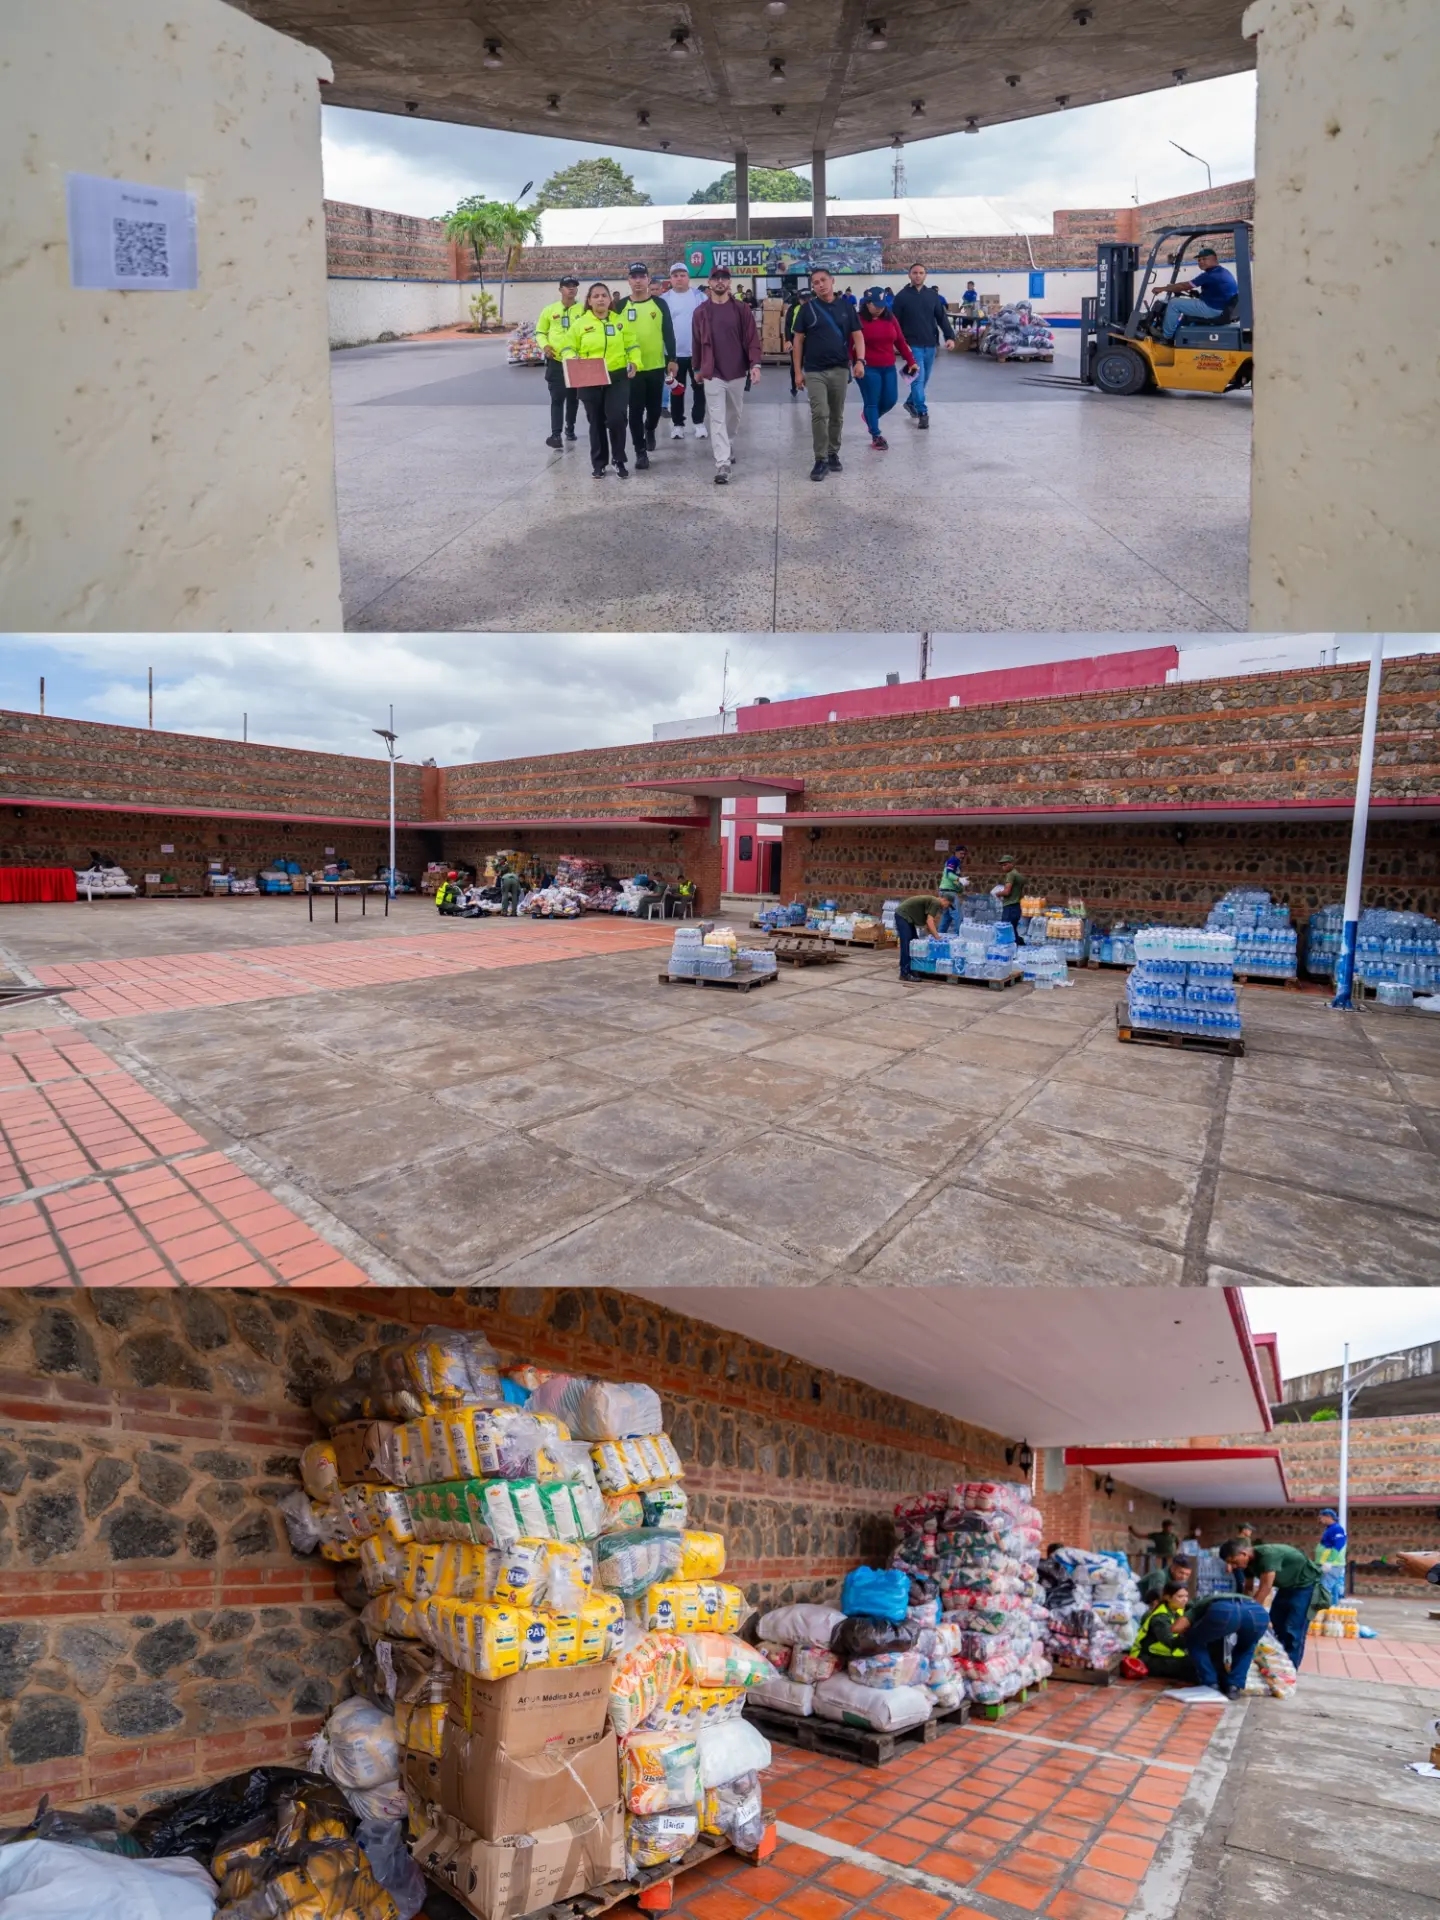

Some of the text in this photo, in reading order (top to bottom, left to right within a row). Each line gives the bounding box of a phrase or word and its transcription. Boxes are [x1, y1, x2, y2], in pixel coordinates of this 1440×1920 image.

[713, 250, 762, 266] VEN 9-1-1
[657, 1604, 672, 1612] PAN
[526, 1627, 546, 1638] PAN
[542, 1693, 567, 1702] Médica
